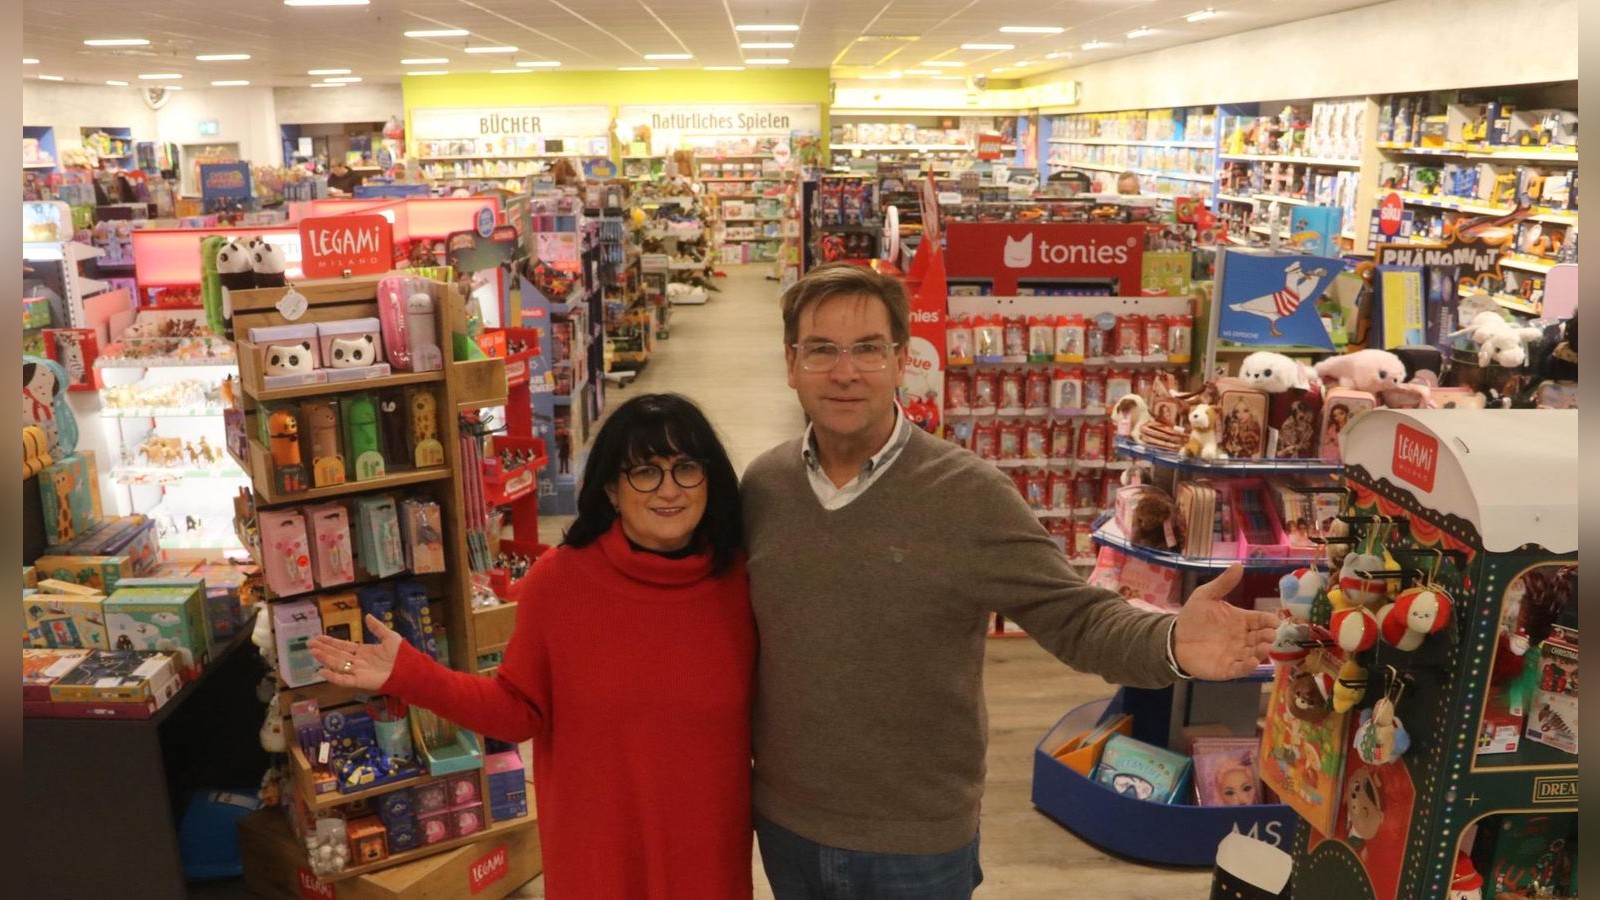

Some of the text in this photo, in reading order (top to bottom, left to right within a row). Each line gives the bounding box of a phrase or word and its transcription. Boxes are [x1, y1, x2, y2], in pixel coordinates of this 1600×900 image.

[480, 113, 541, 134] BÜCHER
[652, 112, 790, 131] Natürliches Spielen
[318, 257, 378, 268] MILANO
[1541, 782, 1578, 795] DREA
